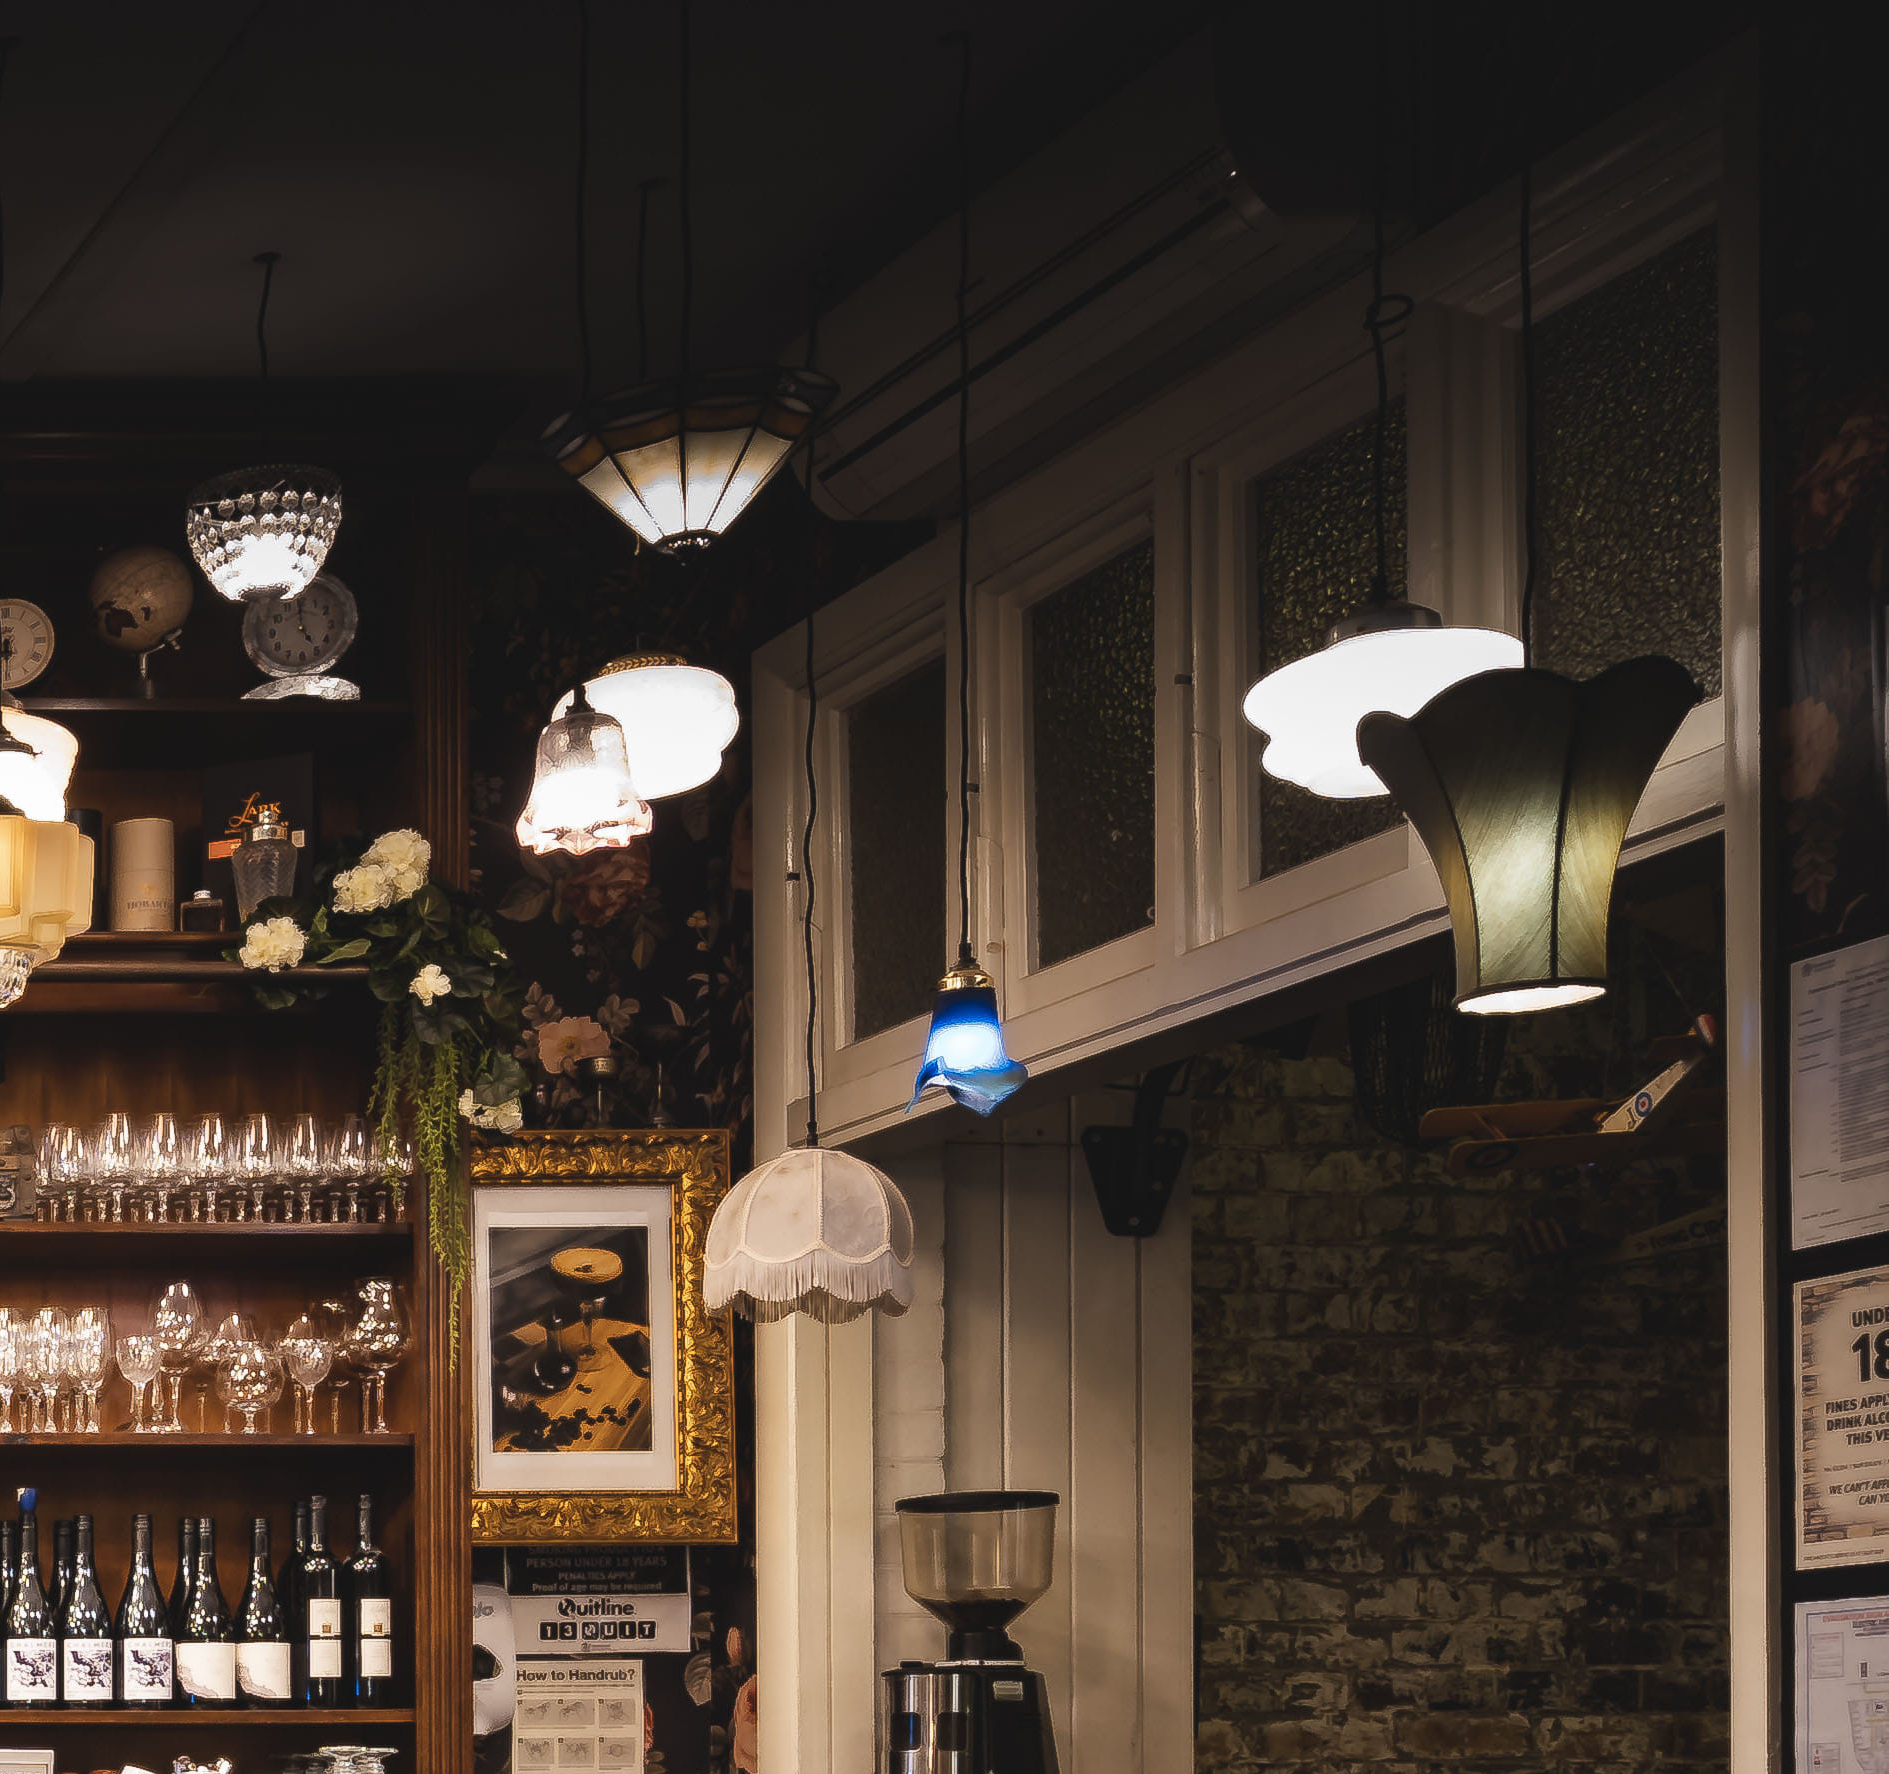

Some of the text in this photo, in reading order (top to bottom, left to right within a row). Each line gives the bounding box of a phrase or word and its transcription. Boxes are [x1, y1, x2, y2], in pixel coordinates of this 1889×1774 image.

[1825, 1398, 1858, 1414] FINES
[1826, 1414, 1862, 1432] DRINK
[1846, 1431, 1873, 1446] THIS
[527, 1557, 668, 1569] PERSON UNDER 18 YEARS
[608, 1572, 636, 1580] APPLY
[532, 1583, 557, 1592] Proof
[570, 1584, 588, 1593] age
[590, 1584, 609, 1592] may
[623, 1582, 662, 1592] required
[542, 1623, 575, 1639] 13
[516, 1669, 635, 1682] How to Handrub?
